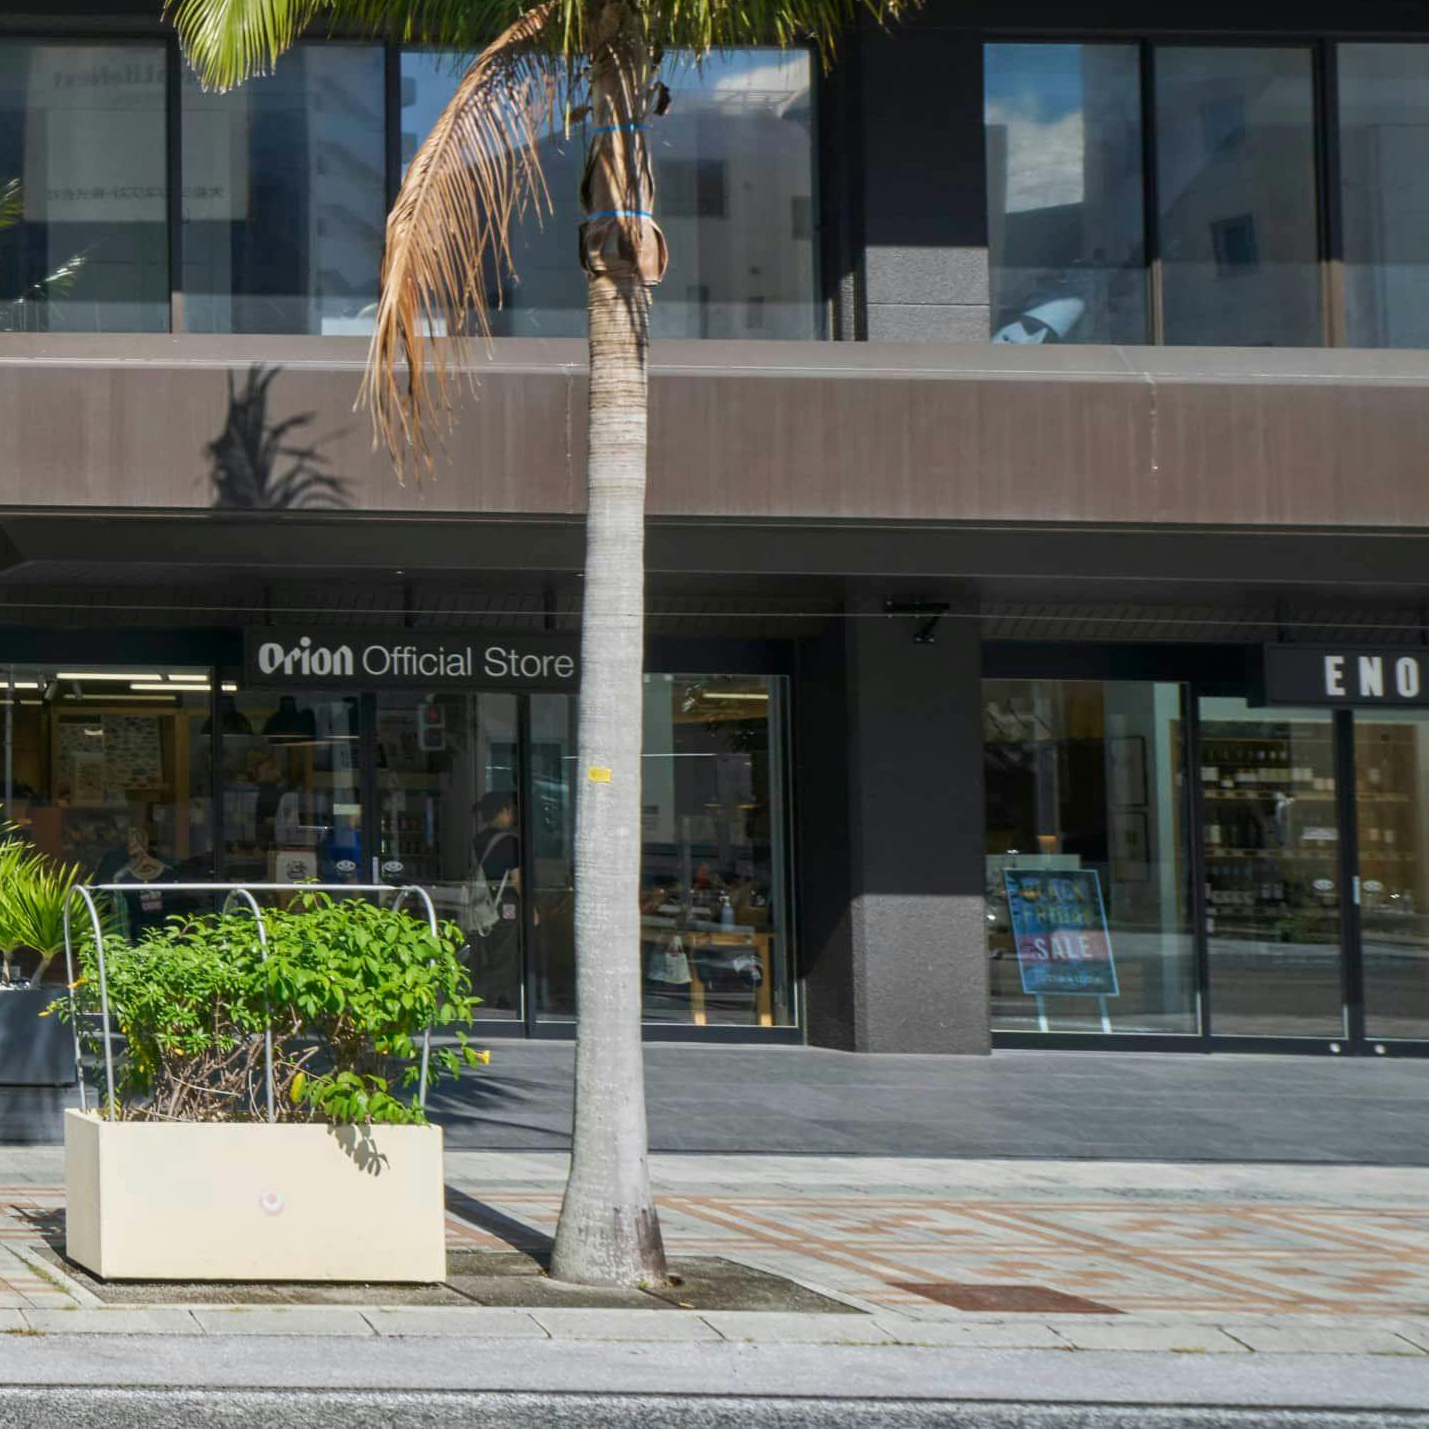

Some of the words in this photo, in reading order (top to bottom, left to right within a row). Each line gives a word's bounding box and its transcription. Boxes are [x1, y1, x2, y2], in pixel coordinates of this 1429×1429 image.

[258, 636, 354, 676] Orion
[362, 645, 472, 676] Official
[484, 647, 574, 677] Store
[1324, 655, 1420, 698] ENO
[1033, 935, 1094, 961] SALE
